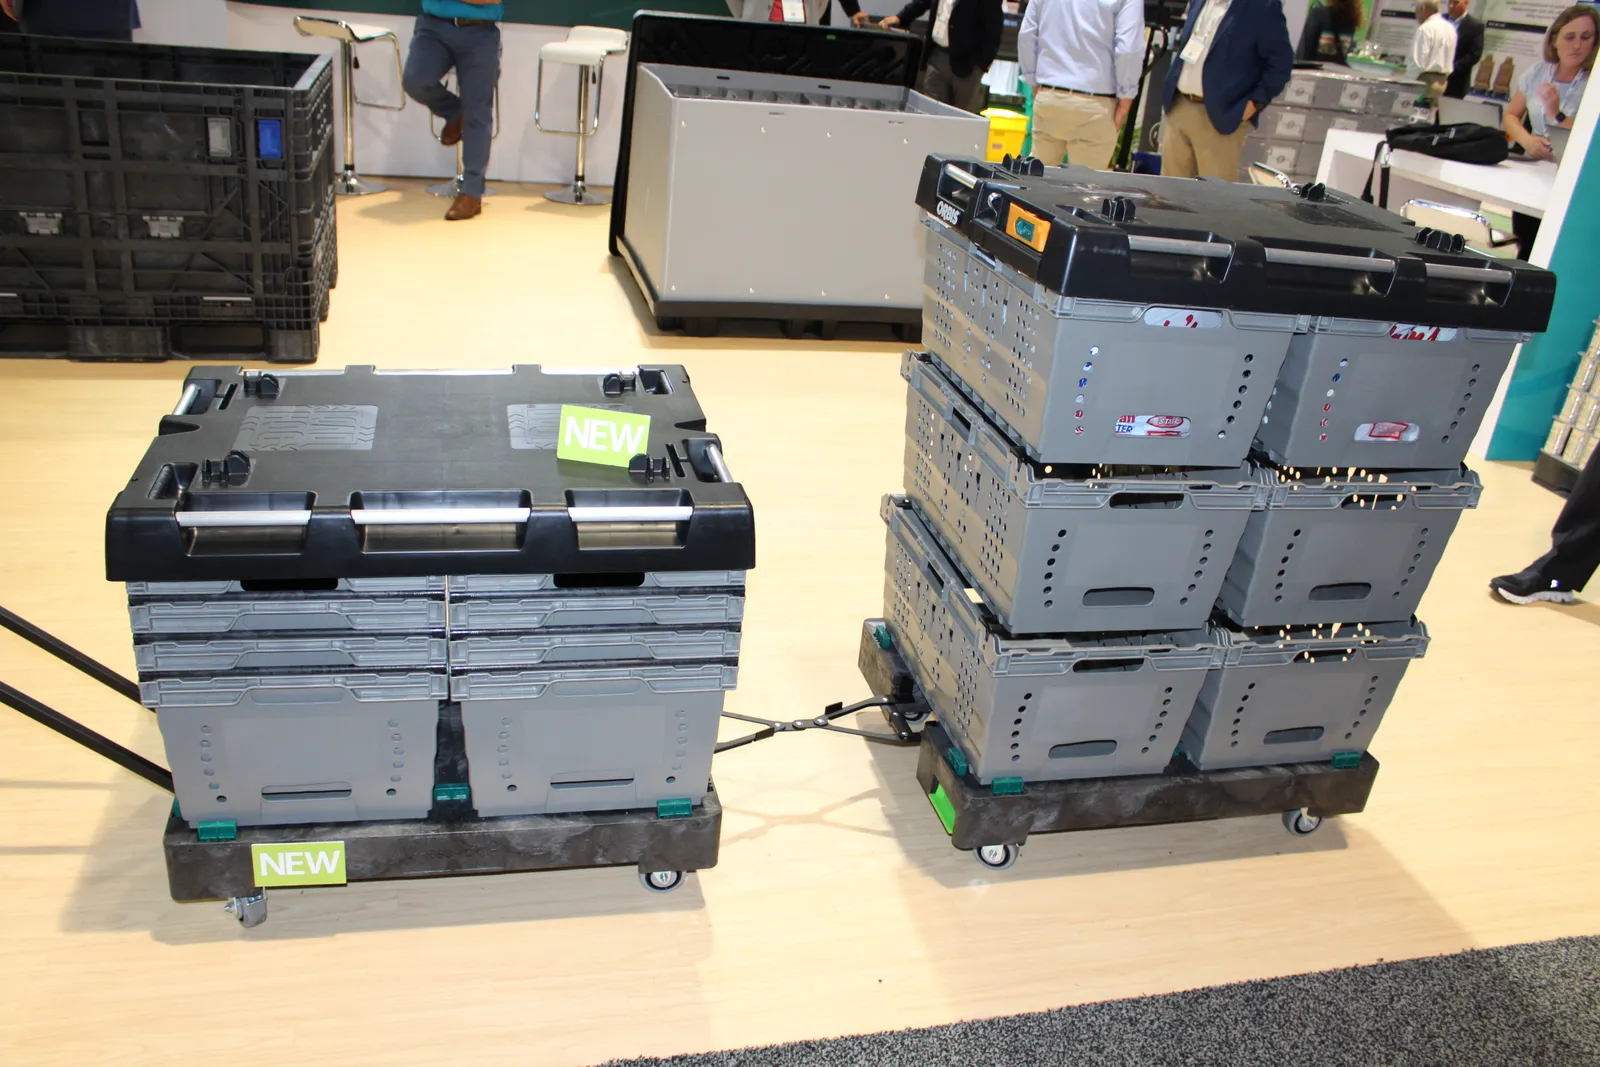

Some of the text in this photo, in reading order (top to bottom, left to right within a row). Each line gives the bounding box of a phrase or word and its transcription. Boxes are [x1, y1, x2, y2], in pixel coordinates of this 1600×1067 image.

[936, 200, 959, 225] ORBIS
[564, 415, 645, 455] NEW
[1115, 424, 1133, 433] TER
[260, 850, 340, 877] NEW
